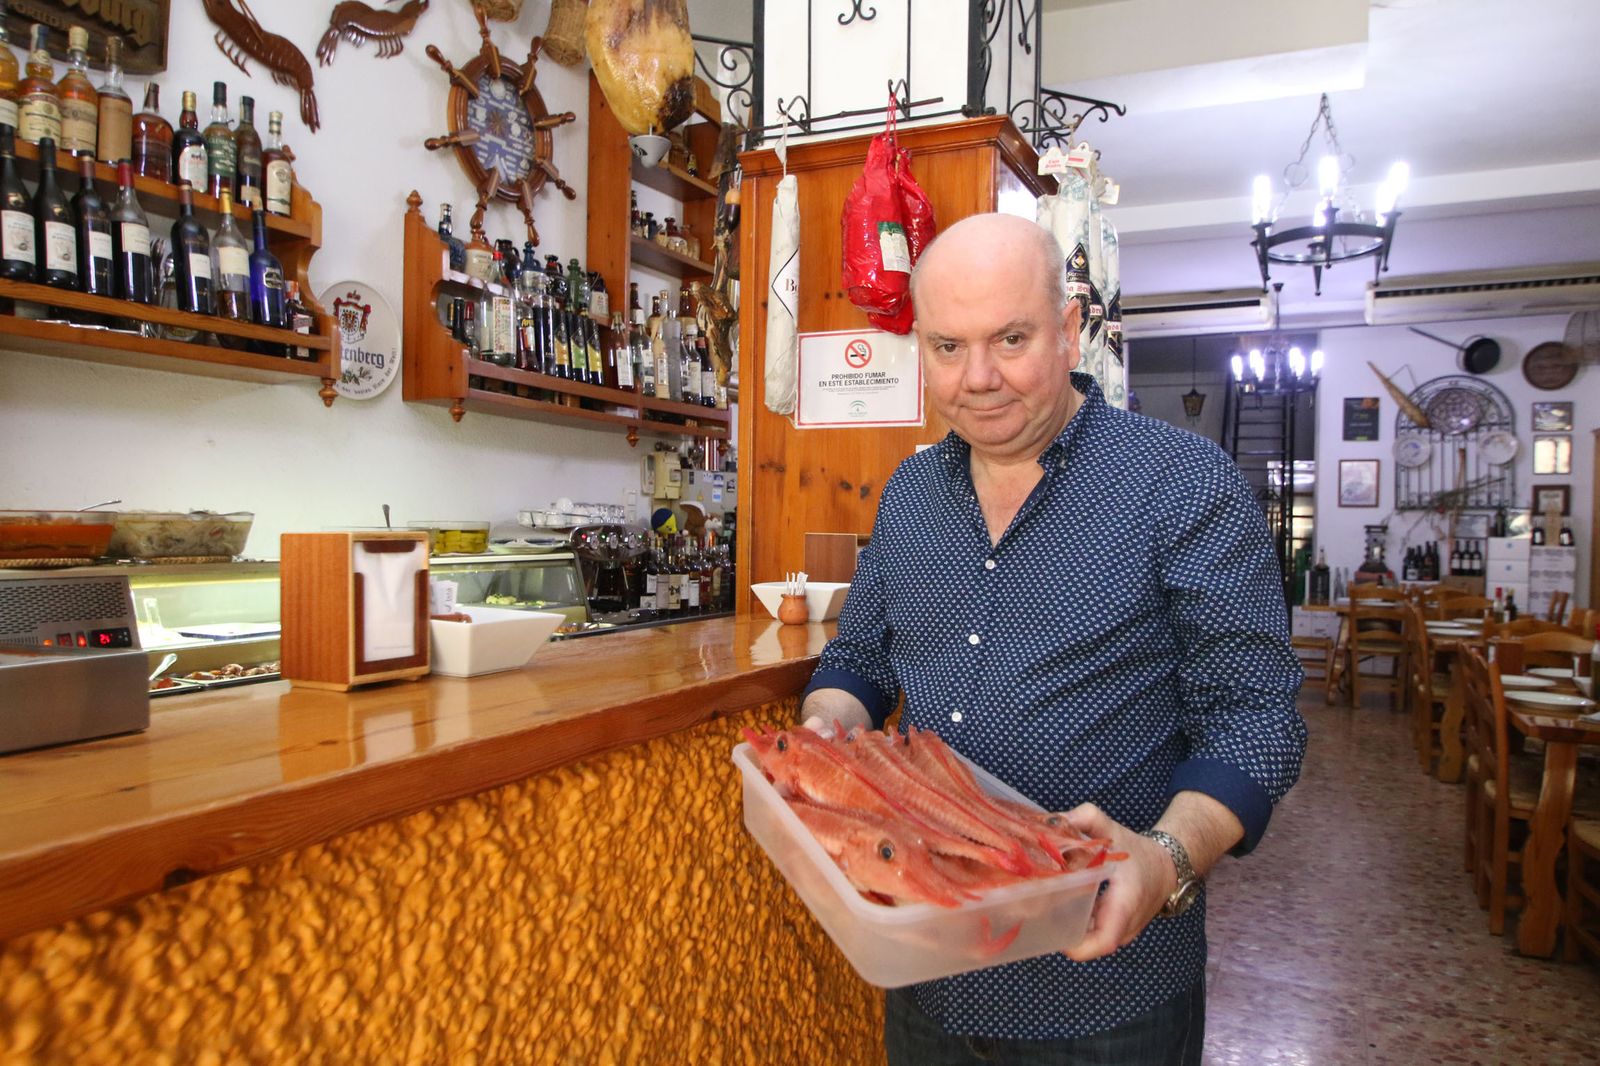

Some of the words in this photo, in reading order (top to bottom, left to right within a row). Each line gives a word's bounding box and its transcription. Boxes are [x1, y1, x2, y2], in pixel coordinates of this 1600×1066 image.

[344, 346, 385, 370] enberg
[831, 372, 864, 380] PROHIBIDO
[865, 371, 886, 379] FUMAR
[828, 379, 843, 387] ESTE
[844, 377, 900, 386] ESTABLECIMIENTO
